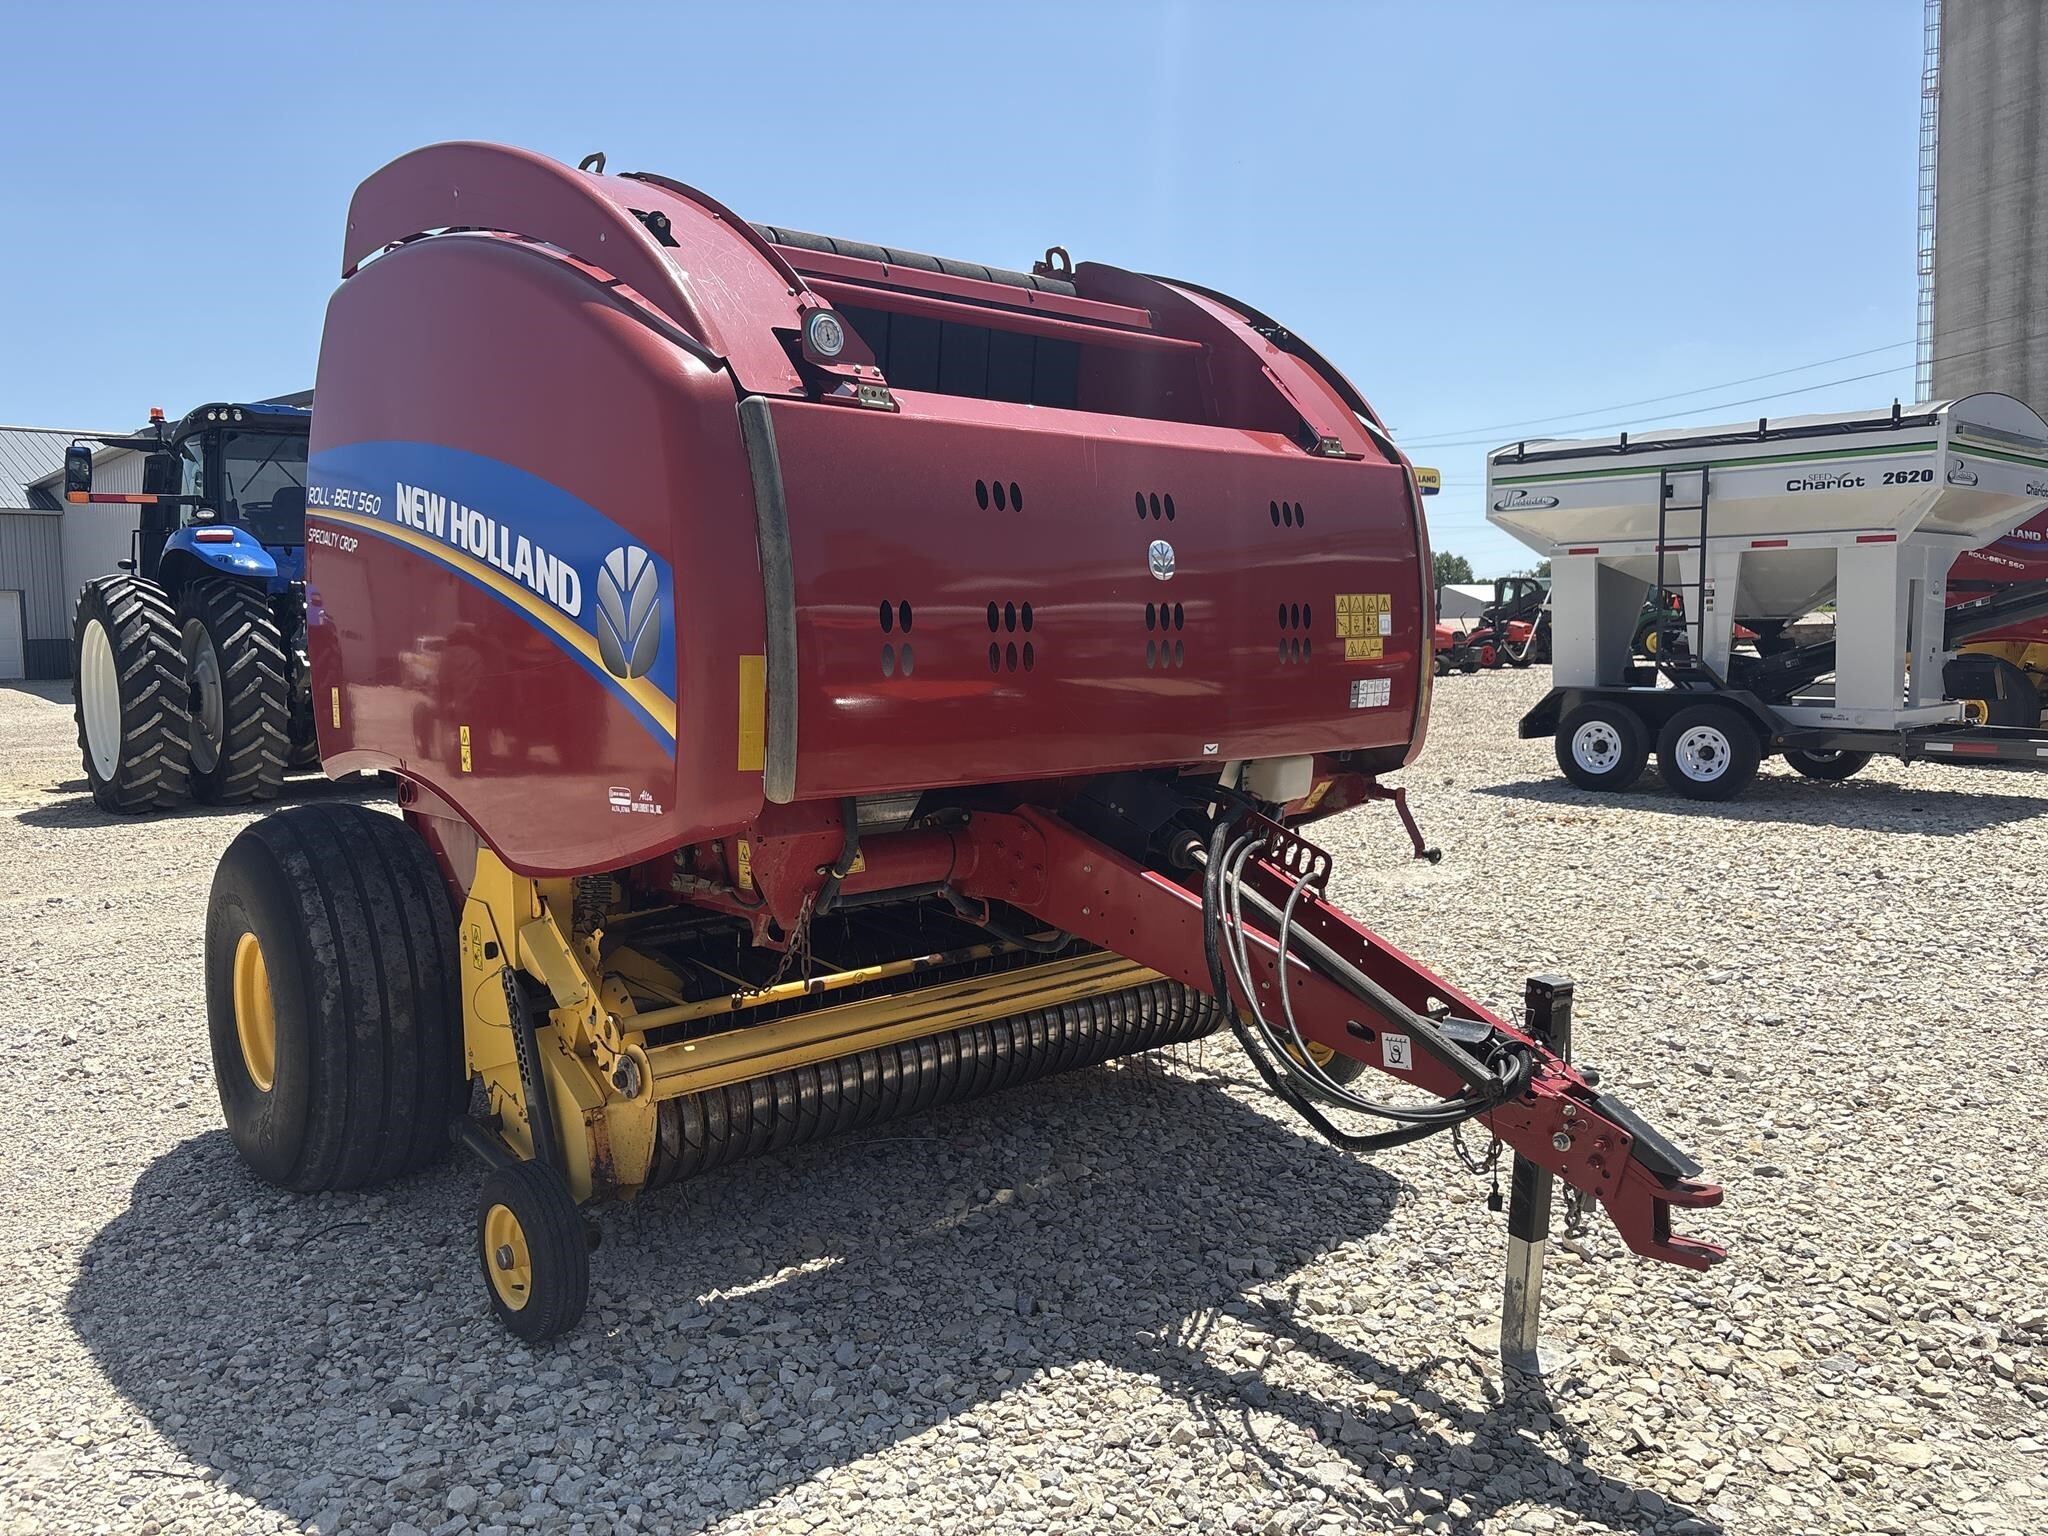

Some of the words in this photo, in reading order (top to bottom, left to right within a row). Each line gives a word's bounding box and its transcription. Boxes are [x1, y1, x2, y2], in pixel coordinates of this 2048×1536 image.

[1417, 475, 1437, 483] LAND
[1787, 473, 1865, 491] Chariot
[1882, 469, 1934, 484] 2620
[308, 487, 358, 509] ROLL-BELT
[358, 492, 382, 515] 560
[308, 528, 340, 547] SPECIALTY
[340, 536, 358, 552] CROP
[2006, 528, 2042, 541] LAND
[396, 482, 446, 537] NEW
[450, 500, 582, 617] HOLLAND
[1968, 551, 2007, 565] ROLL-BELT
[2008, 560, 2025, 570] 560
